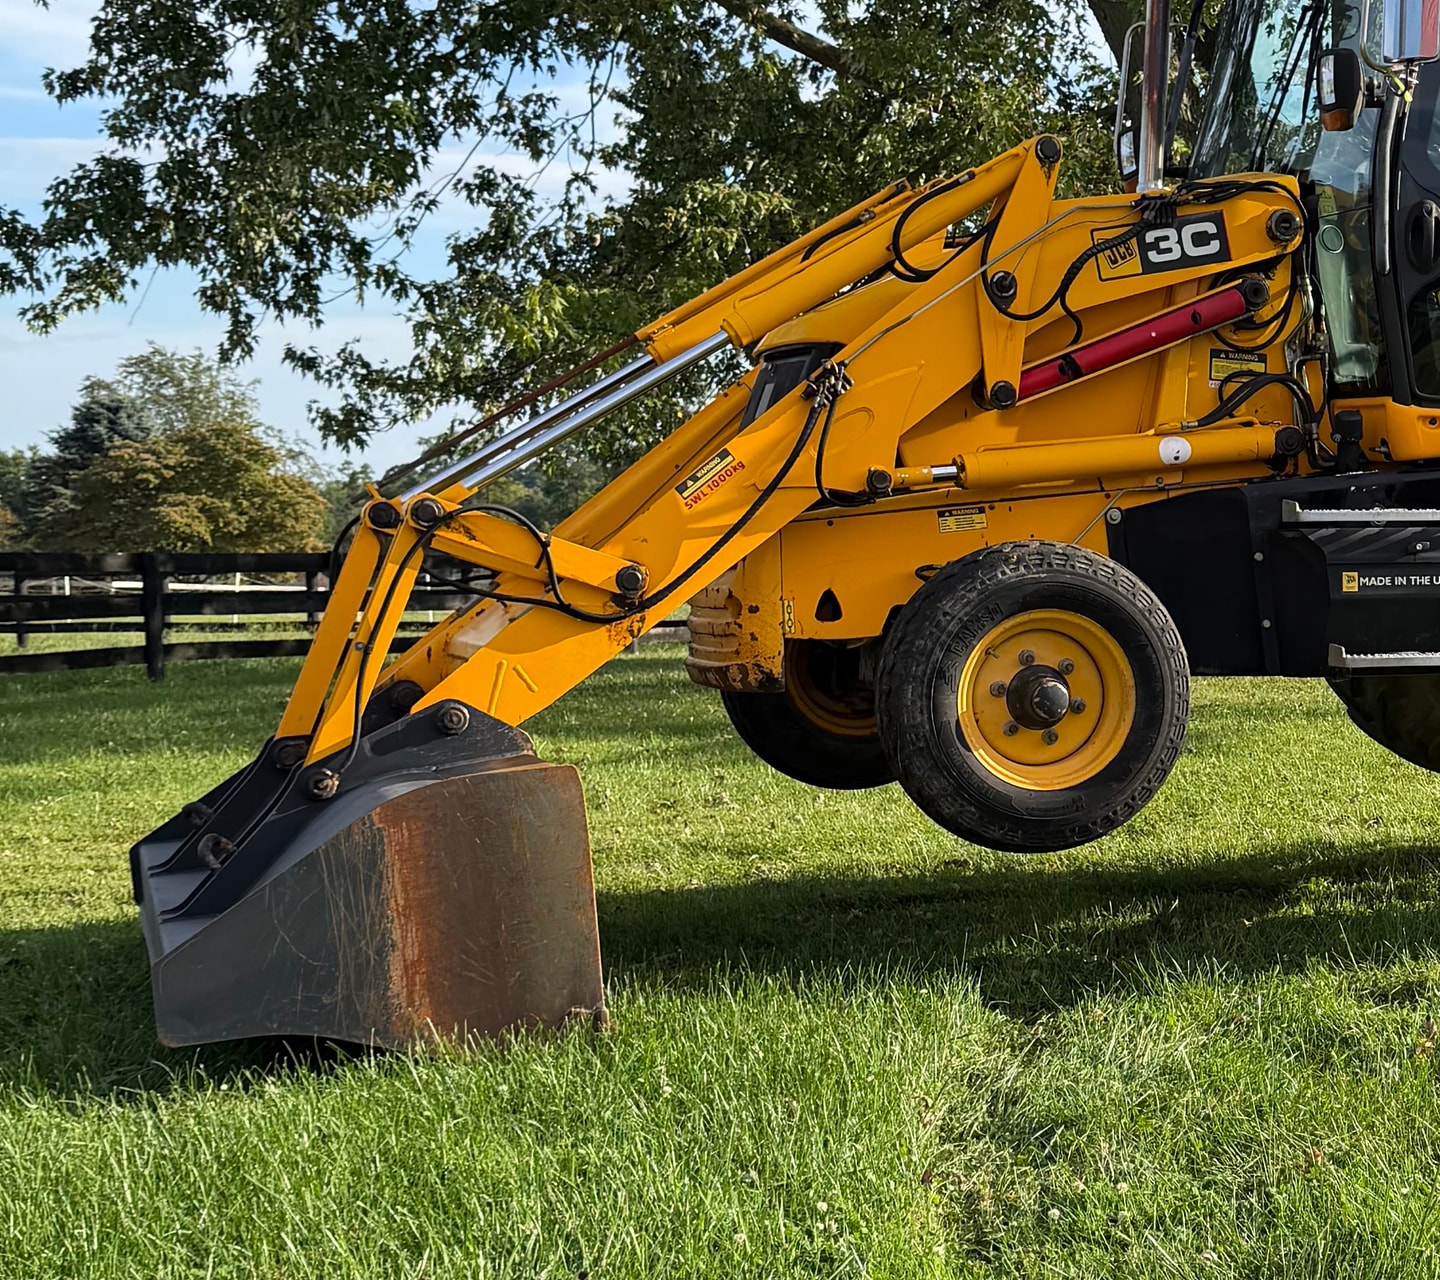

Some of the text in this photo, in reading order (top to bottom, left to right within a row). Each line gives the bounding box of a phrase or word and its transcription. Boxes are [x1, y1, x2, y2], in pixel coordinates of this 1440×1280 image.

[1106, 221, 1220, 266] JCB 3C
[684, 490, 709, 510] SWL
[707, 460, 746, 491] 1000kg
[1359, 576, 1392, 586] MADE
[1394, 576, 1407, 586] IN
[1409, 576, 1431, 585] THE
